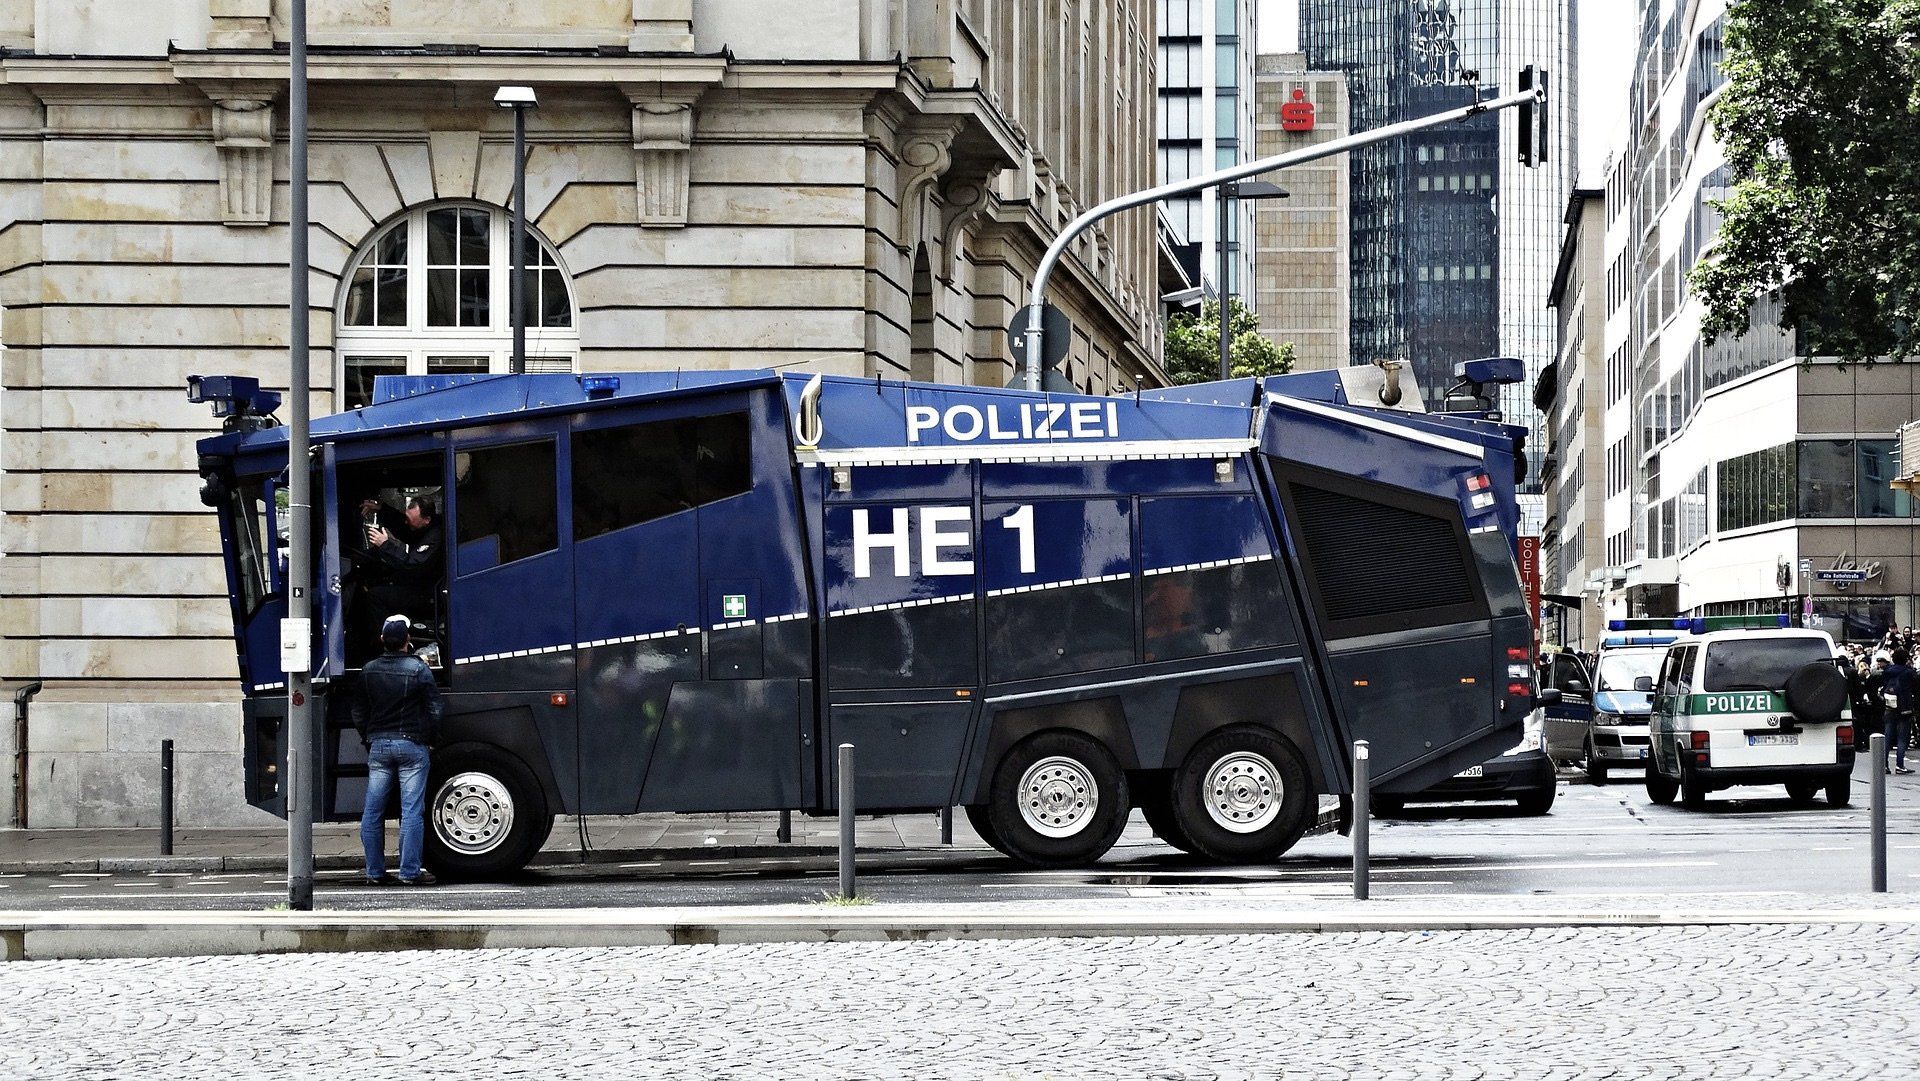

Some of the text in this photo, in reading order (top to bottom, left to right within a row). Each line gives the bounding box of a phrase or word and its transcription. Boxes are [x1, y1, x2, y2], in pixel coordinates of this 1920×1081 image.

[907, 402, 1119, 444] POLIZEI
[852, 505, 1036, 578] HE 1
[1707, 695, 1771, 712] POLIZEI
